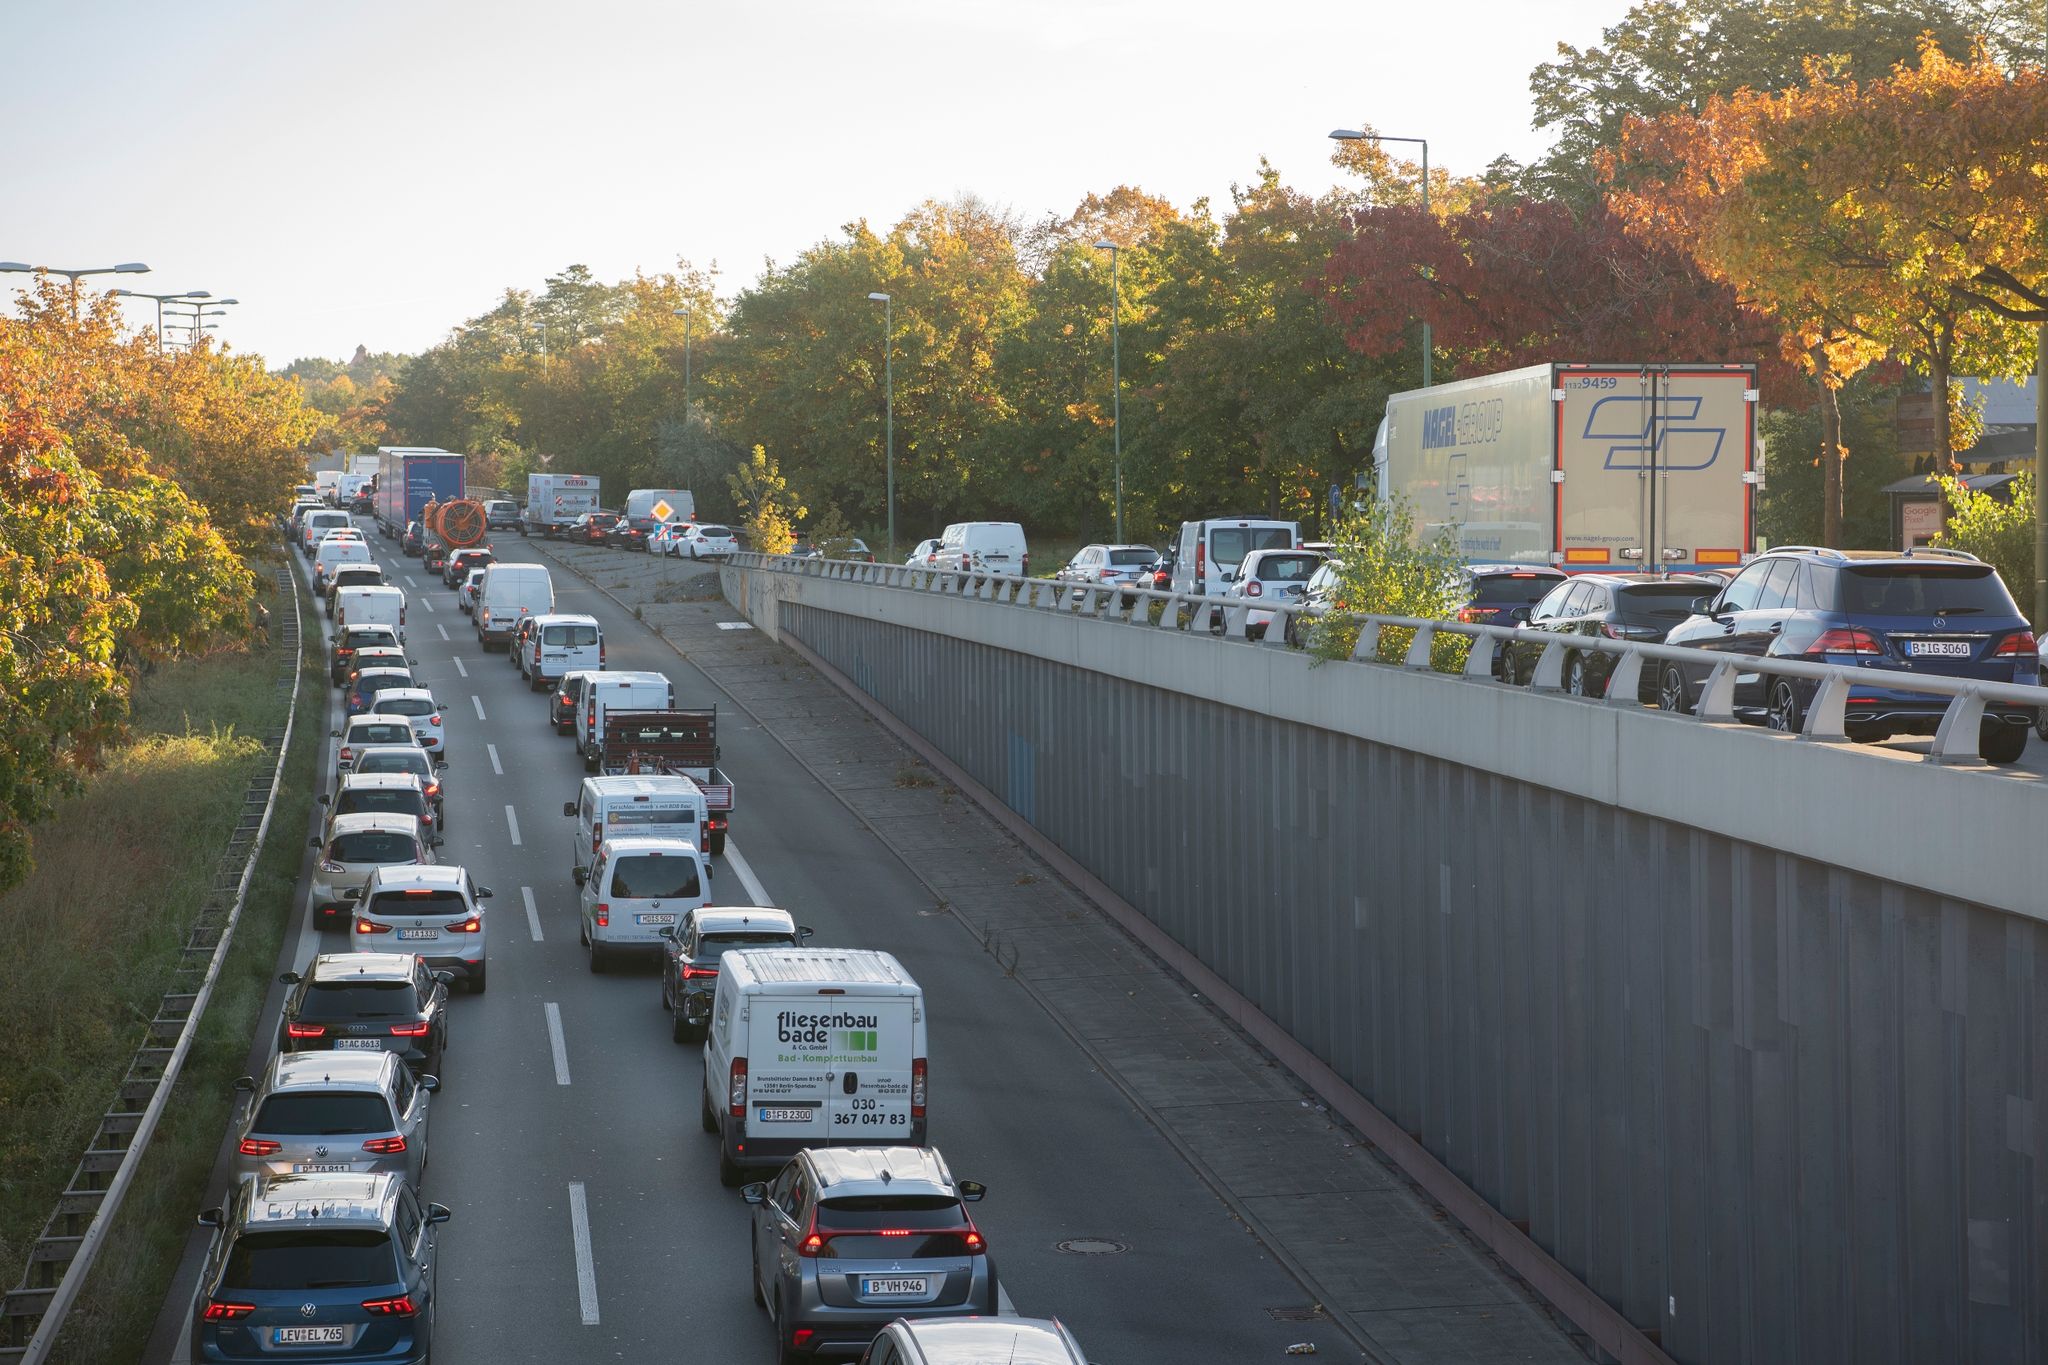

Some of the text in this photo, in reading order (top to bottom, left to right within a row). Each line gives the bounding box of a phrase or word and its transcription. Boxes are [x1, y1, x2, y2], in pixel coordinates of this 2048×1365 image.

[1904, 506, 1937, 516] Google
[777, 1011, 878, 1028] fliesenbau
[778, 1025, 828, 1043] bade
[852, 1099, 876, 1110] 030
[834, 1114, 906, 1125] 367 047 83
